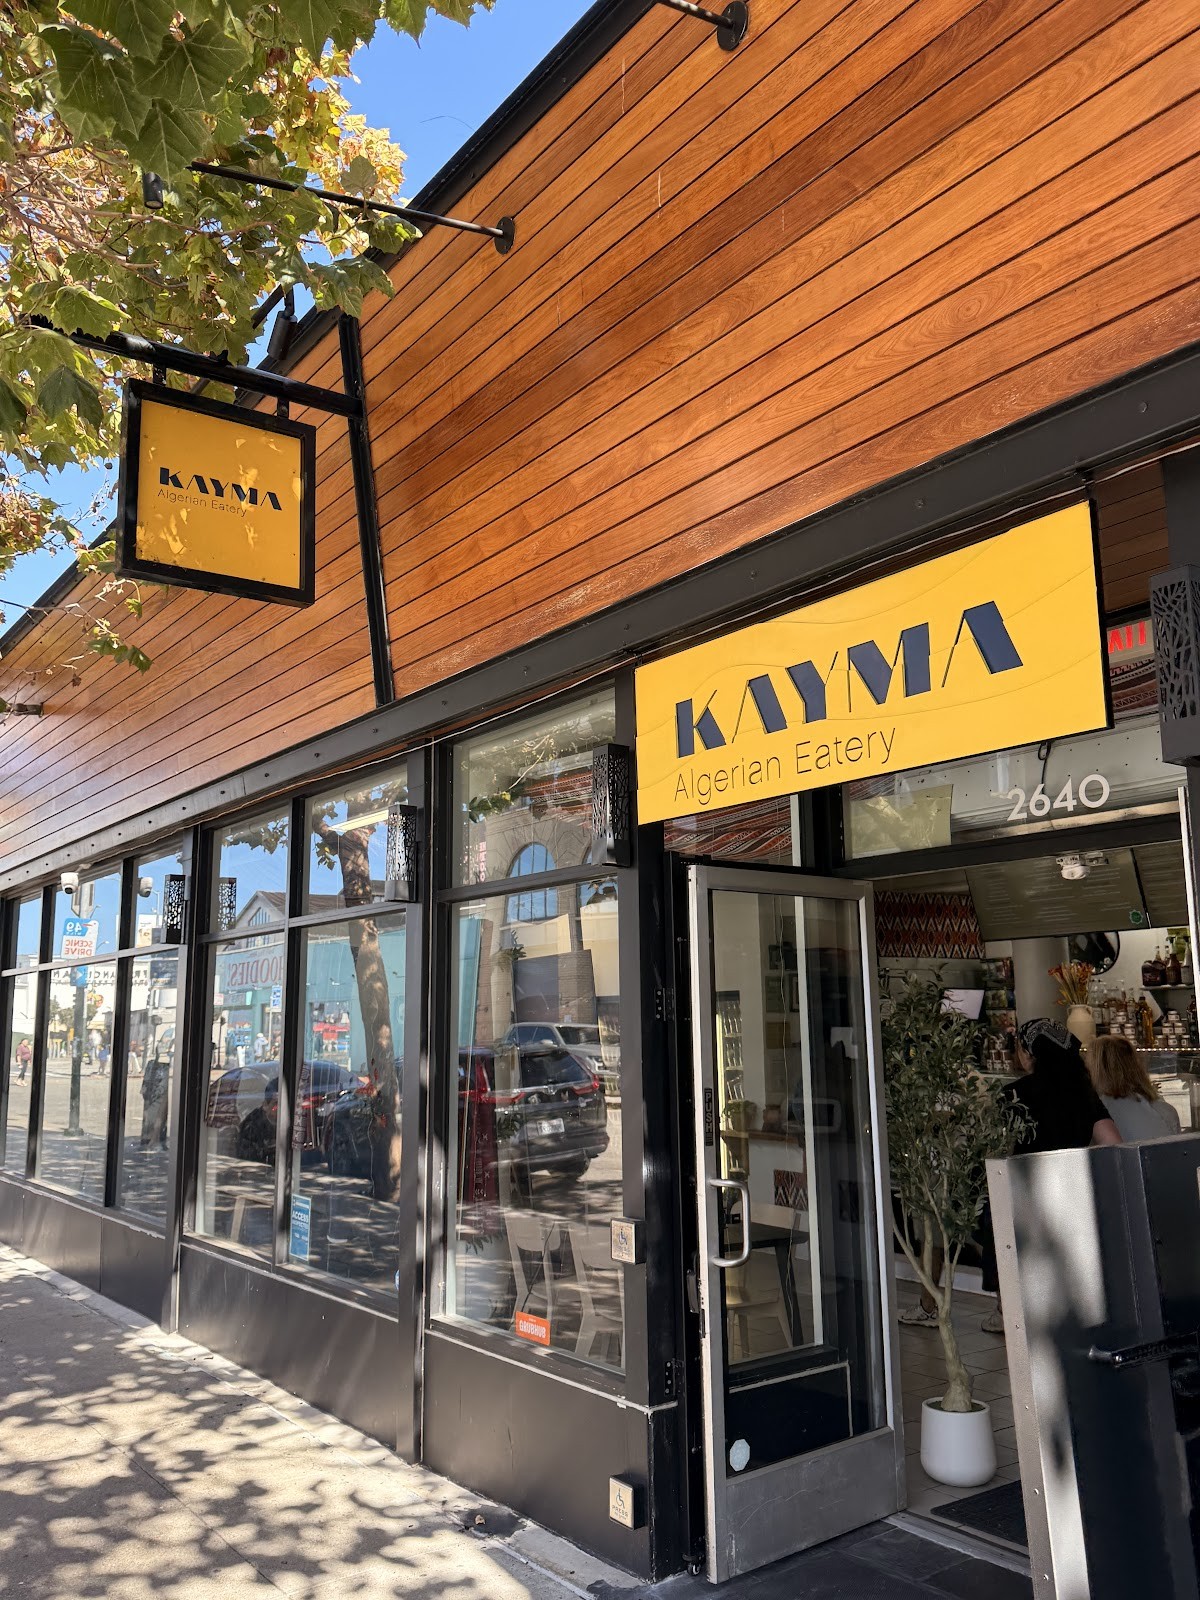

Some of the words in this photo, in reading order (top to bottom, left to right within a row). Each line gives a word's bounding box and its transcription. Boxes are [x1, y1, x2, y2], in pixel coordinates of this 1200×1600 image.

[157, 488, 207, 508] Algerian
[211, 499, 247, 518] Eatery
[160, 467, 282, 511] KAYMA
[675, 600, 1023, 758] KAYMA
[674, 756, 782, 805] Algerian
[796, 727, 896, 774] Eatery
[1007, 773, 1110, 821] 2640
[705, 1092, 713, 1133] PUSH
[292, 1210, 309, 1223] ACCESS
[519, 1320, 546, 1338] GRUBHUB
